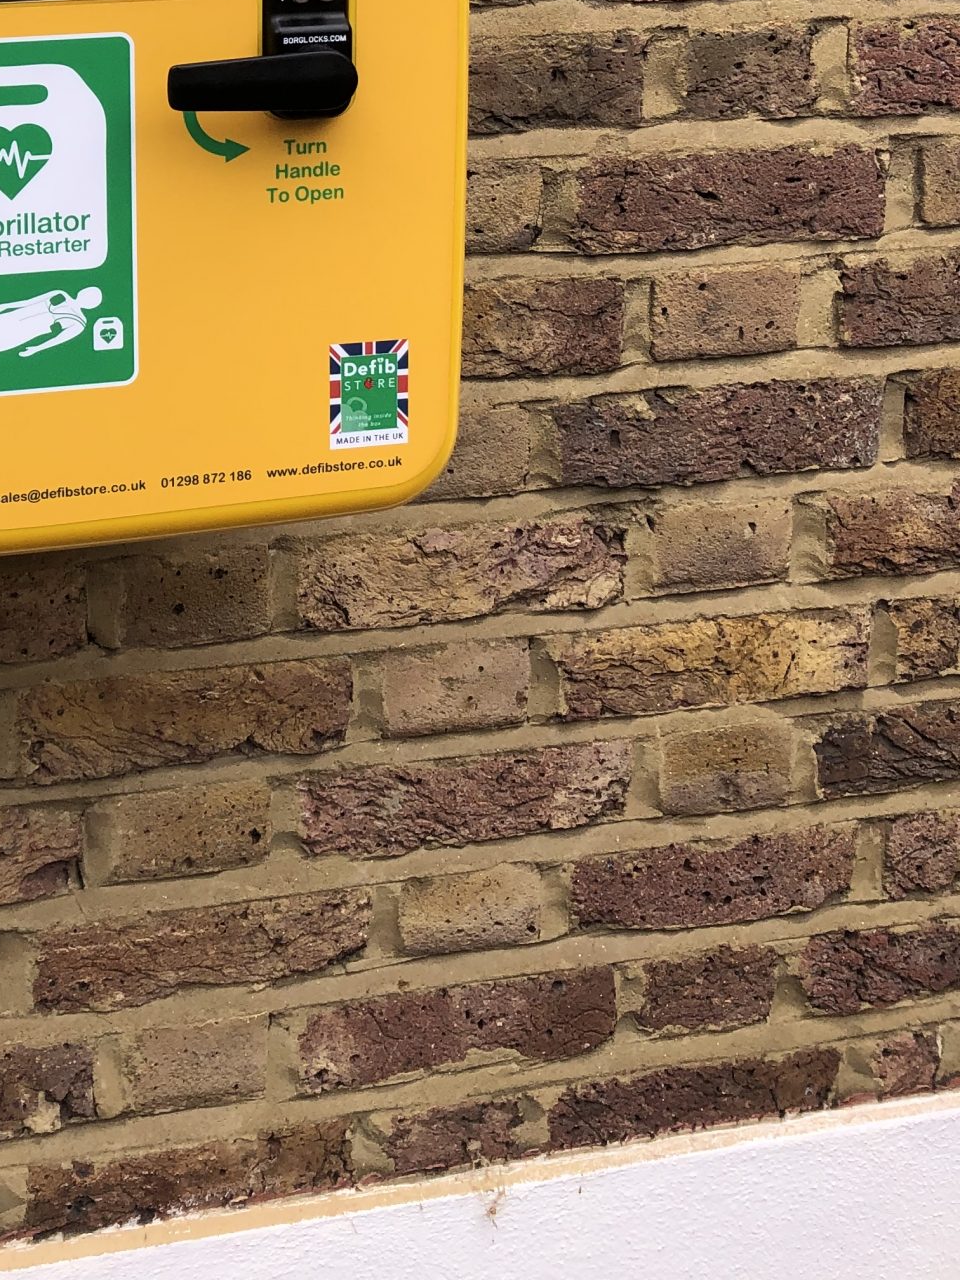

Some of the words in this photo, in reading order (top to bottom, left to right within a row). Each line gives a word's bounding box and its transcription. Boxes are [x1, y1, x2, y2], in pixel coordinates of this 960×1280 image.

[283, 34, 347, 45] BORGLOCKS.COM
[283, 139, 327, 155] Turn
[275, 161, 341, 179] Handle
[266, 188, 290, 204] To
[294, 185, 344, 205] Open
[343, 357, 396, 377] Defib
[336, 435, 361, 445] MADE
[362, 434, 372, 442] IN
[374, 433, 390, 441] THE
[392, 431, 404, 440] UK
[160, 475, 200, 489] 01298
[202, 472, 226, 485] 872
[229, 469, 253, 482] 186
[266, 455, 403, 478] www.defibstore.co.uk
